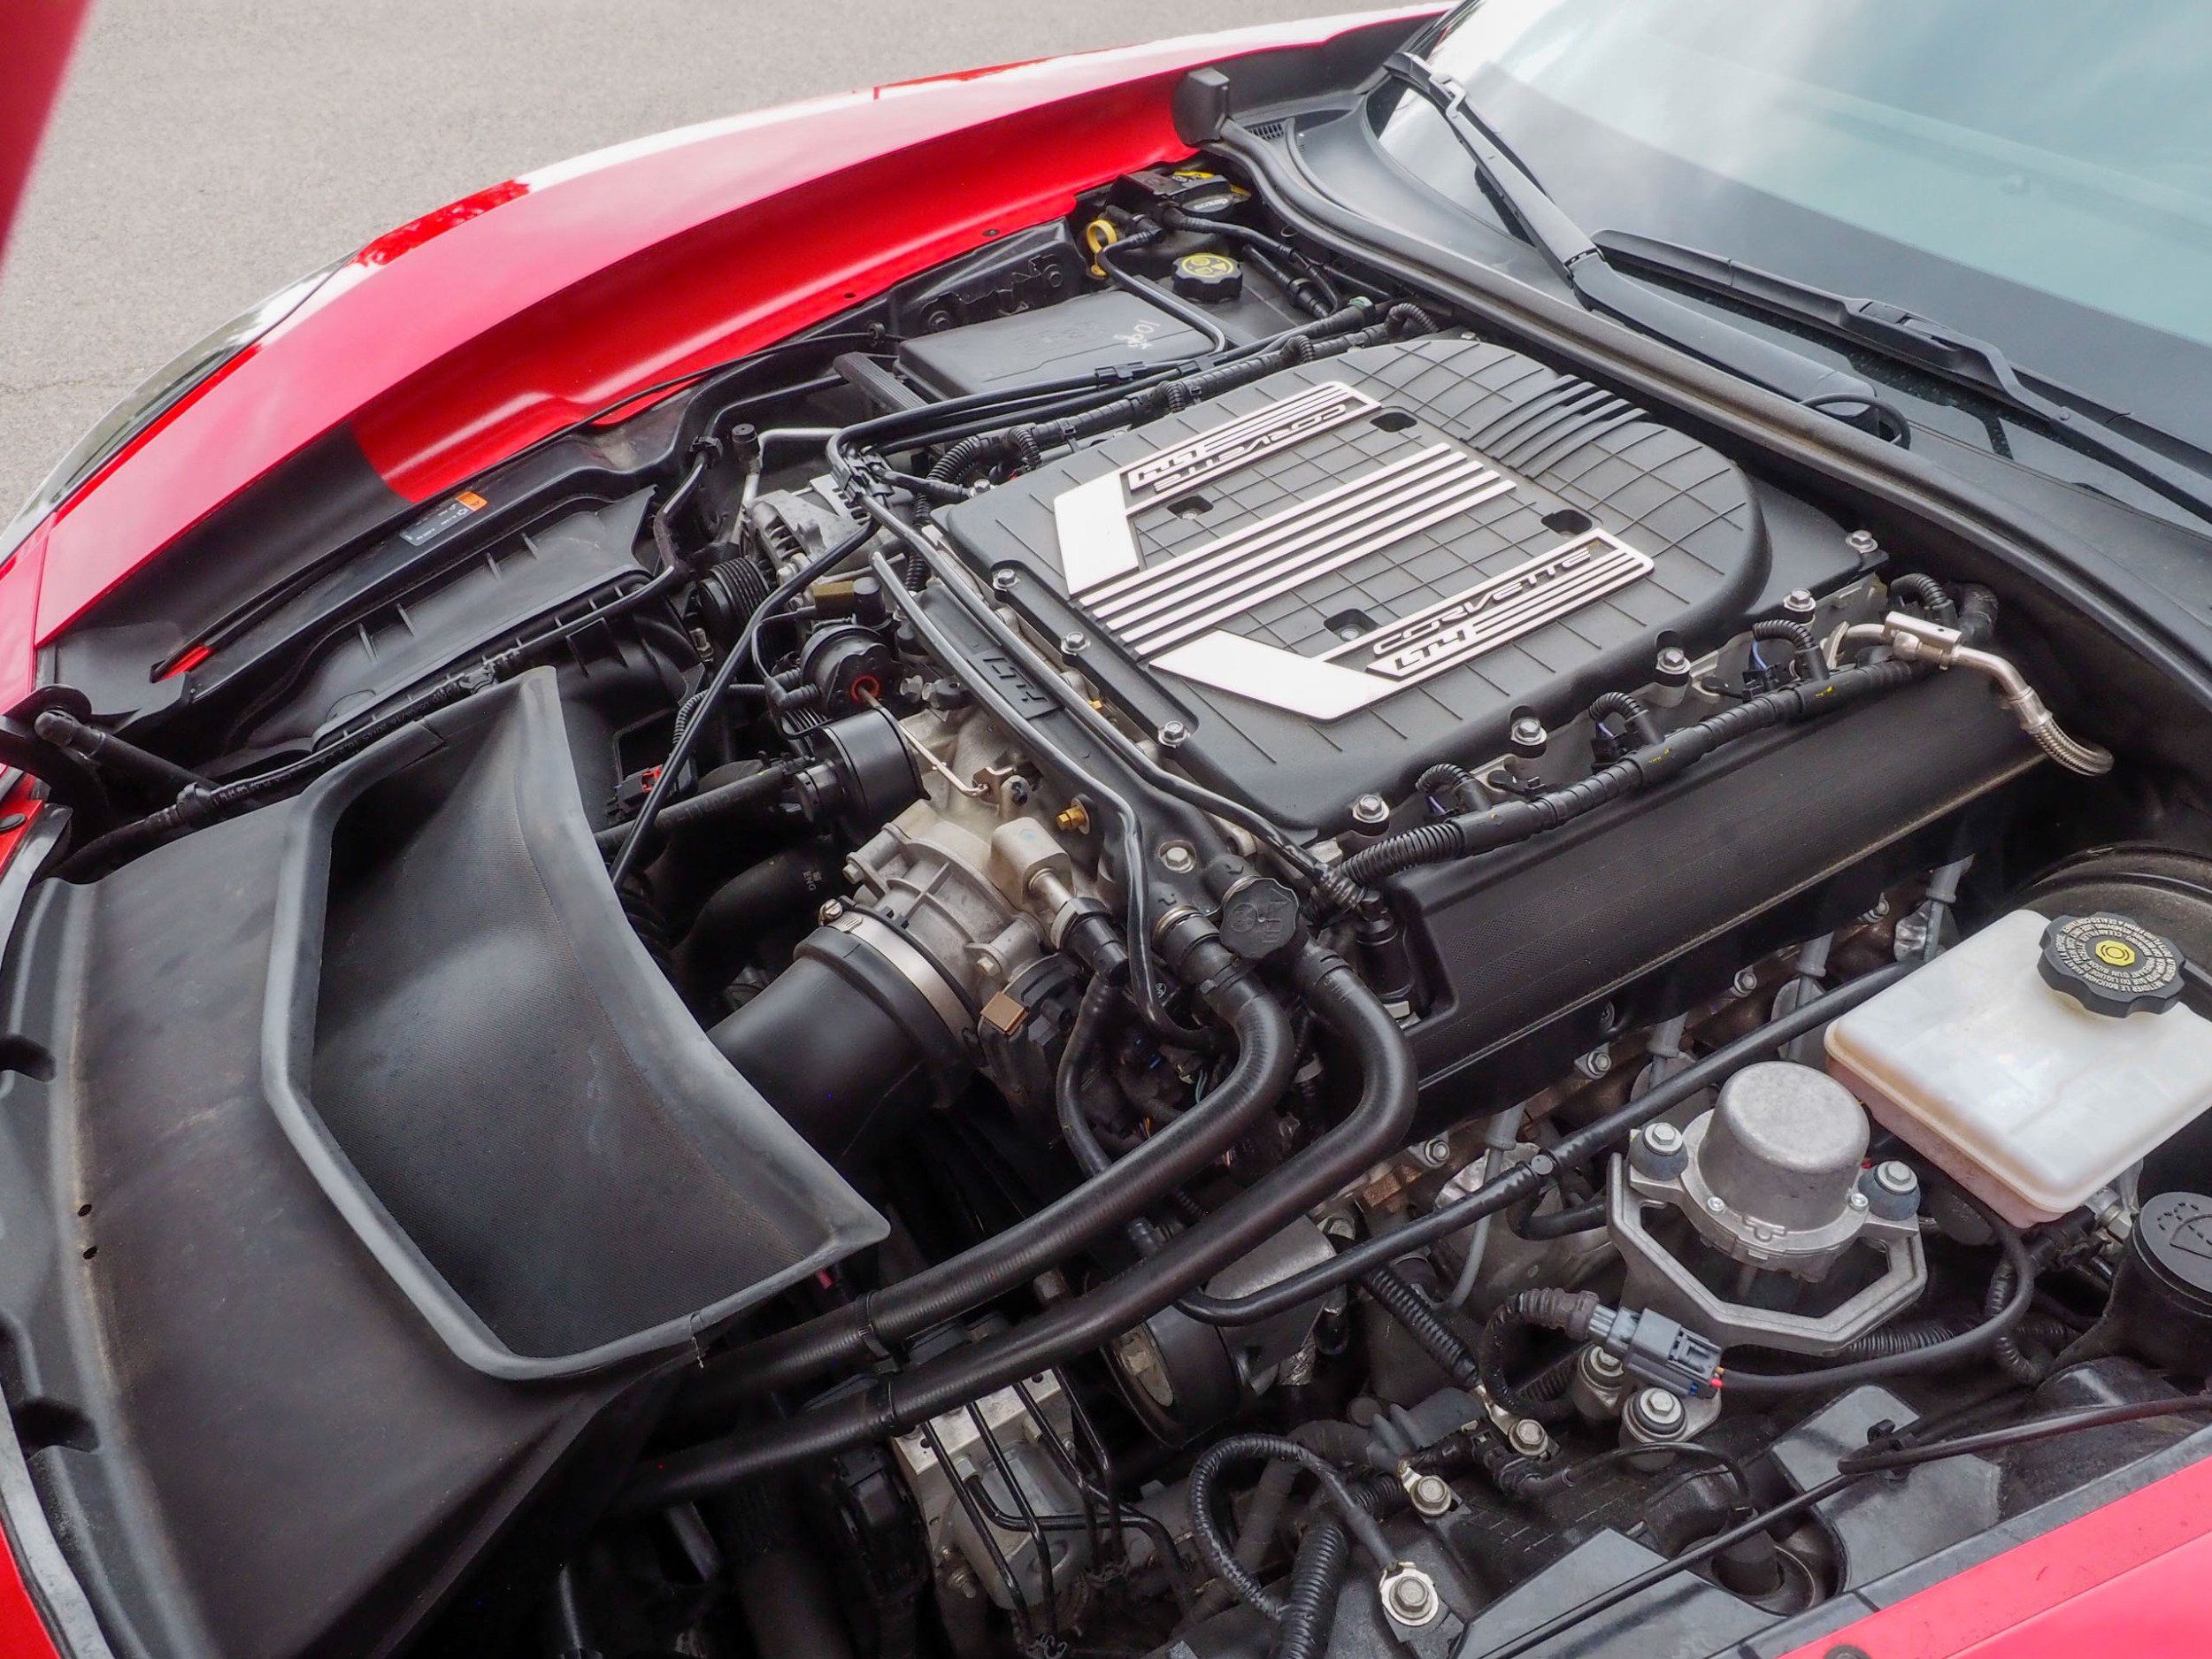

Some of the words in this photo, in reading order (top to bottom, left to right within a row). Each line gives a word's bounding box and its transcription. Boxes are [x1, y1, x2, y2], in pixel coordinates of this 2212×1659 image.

[1128, 442, 1207, 490] LT4
[1154, 403, 1347, 492] CORVETTE
[1373, 547, 1591, 656] CORVETTE
[1397, 619, 1479, 669] LT4
[983, 658, 1048, 702] LT4
